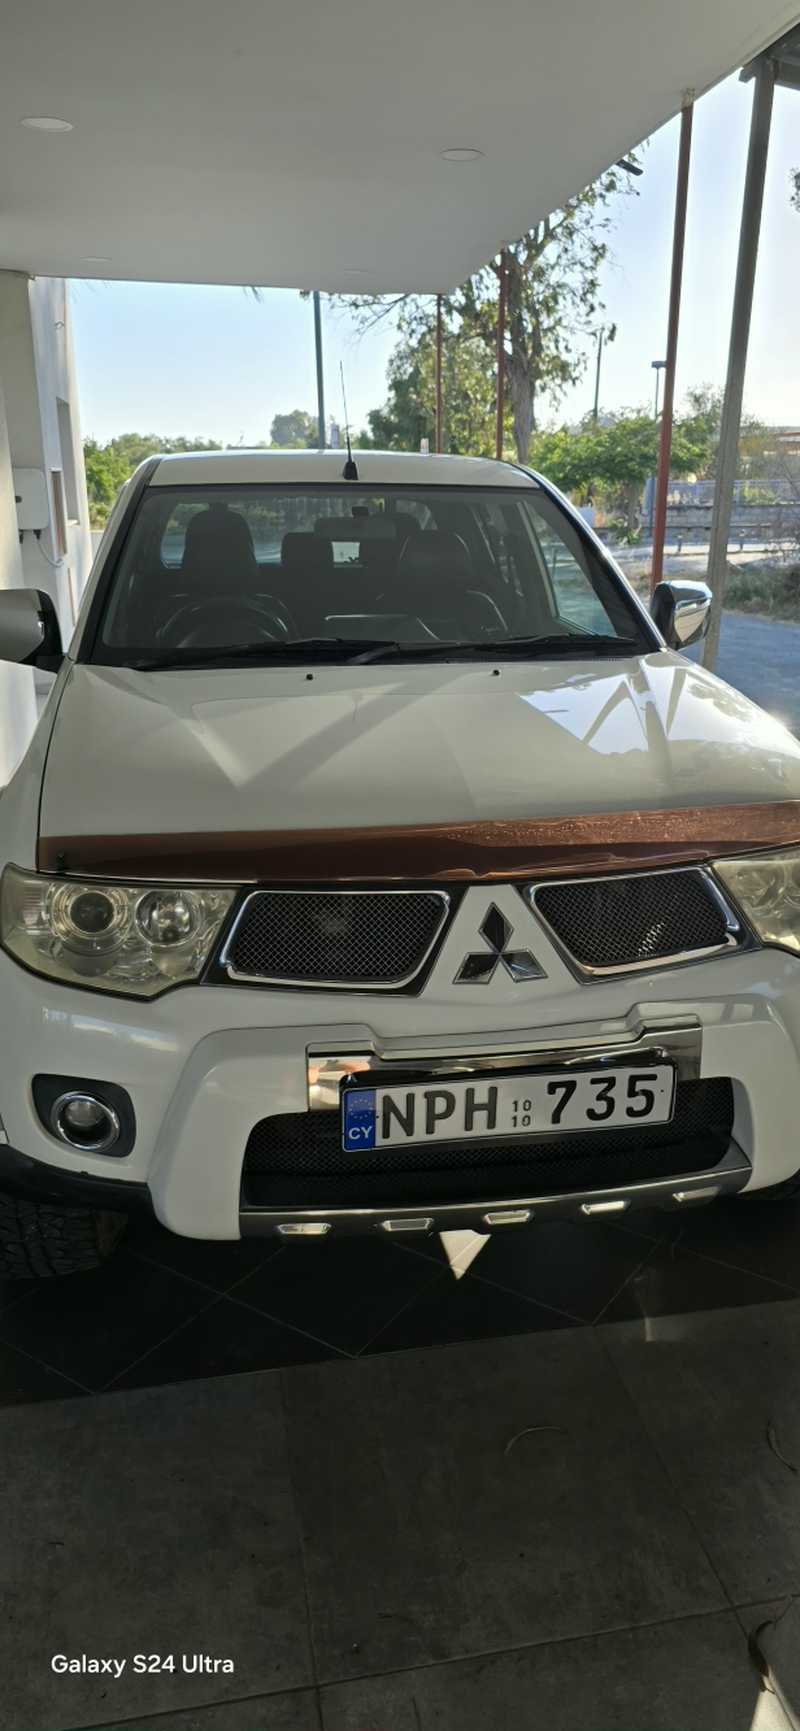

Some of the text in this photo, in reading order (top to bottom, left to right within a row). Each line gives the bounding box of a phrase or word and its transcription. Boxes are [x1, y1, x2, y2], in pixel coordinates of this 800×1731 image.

[382, 1073, 658, 1139] NPH 735
[512, 1099, 532, 1113] 10
[511, 1115, 531, 1127] 10
[348, 1125, 373, 1140] CY
